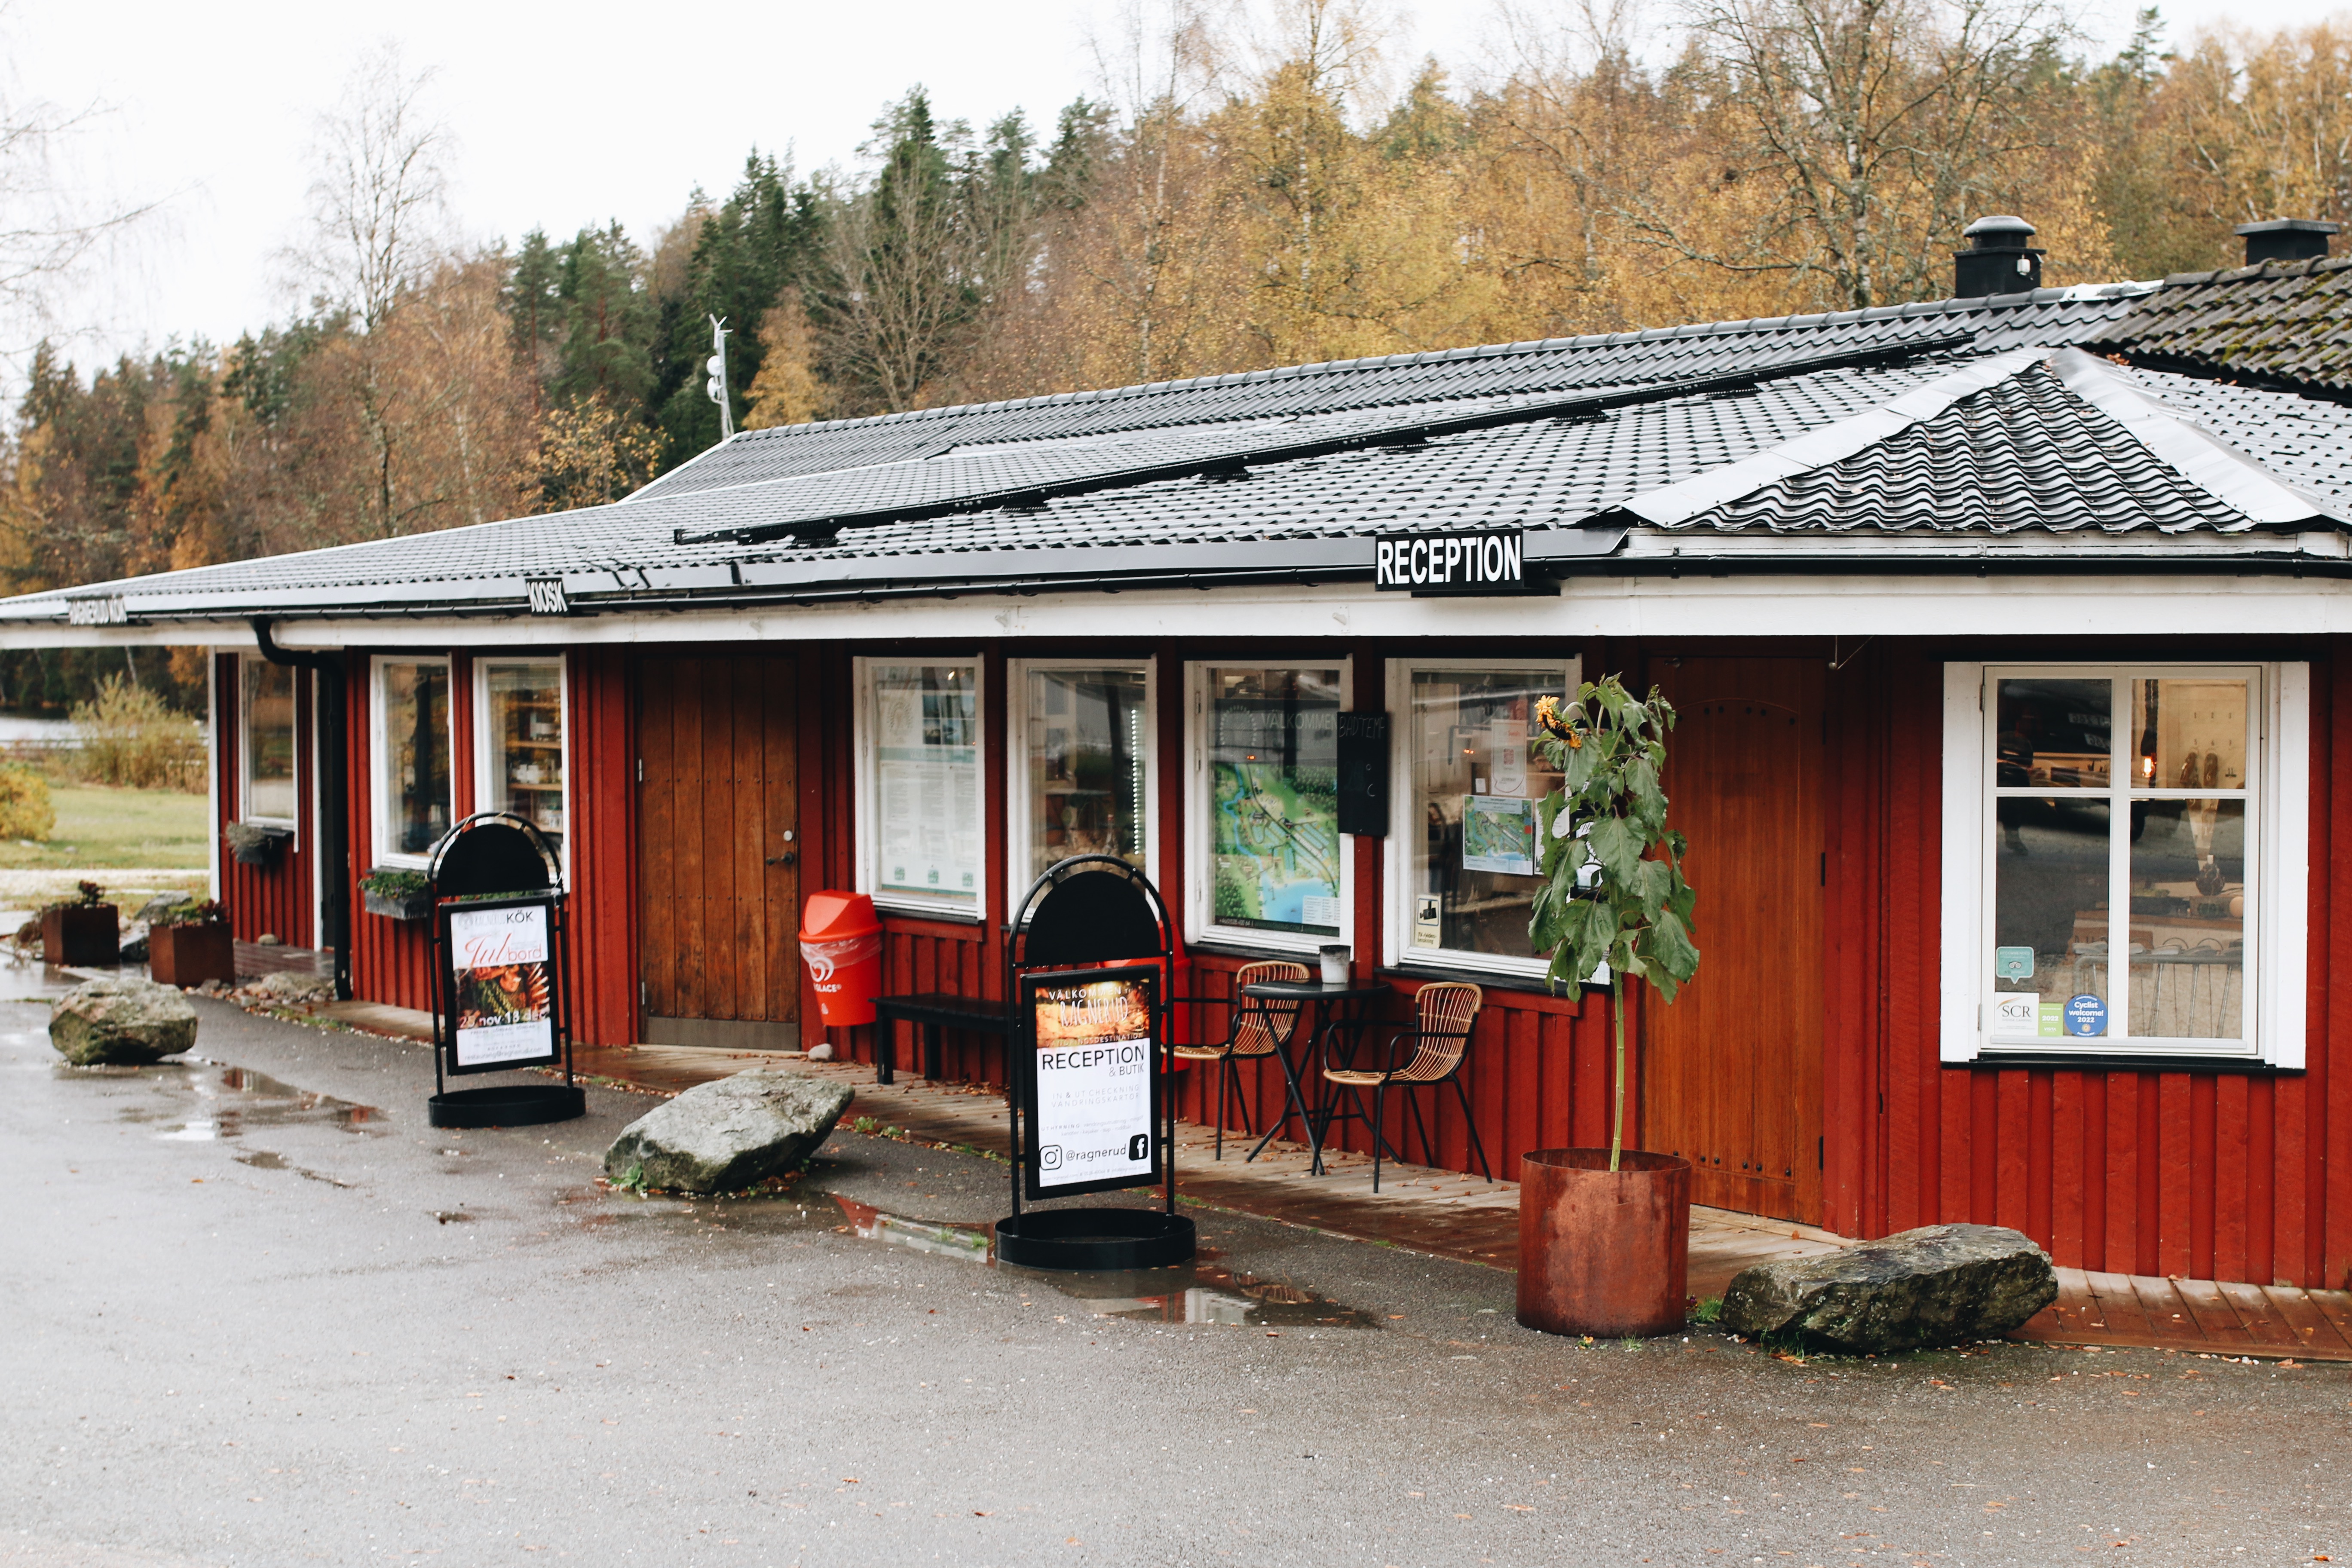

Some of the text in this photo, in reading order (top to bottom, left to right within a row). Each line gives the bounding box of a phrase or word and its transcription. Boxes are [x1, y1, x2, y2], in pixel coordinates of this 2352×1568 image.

[1377, 535, 1521, 585] RECEPTION
[527, 581, 568, 612] KIOSK
[507, 910, 533, 924] KÖK
[1049, 986, 1121, 1000] VÄLKOMMEN
[1060, 996, 1128, 1027] RAGNERUD
[2002, 1005, 2031, 1017] SCR
[2074, 1001, 2098, 1009] Cyclist
[1042, 1044, 1144, 1070] RECEPTION
[1109, 1063, 1144, 1077] & BUTIK
[1051, 1092, 1139, 1108] VANDRINGSKARTOR
[1041, 1123, 1080, 1131] UTHYRNING
[1066, 1143, 1126, 1162] @ragnerud
